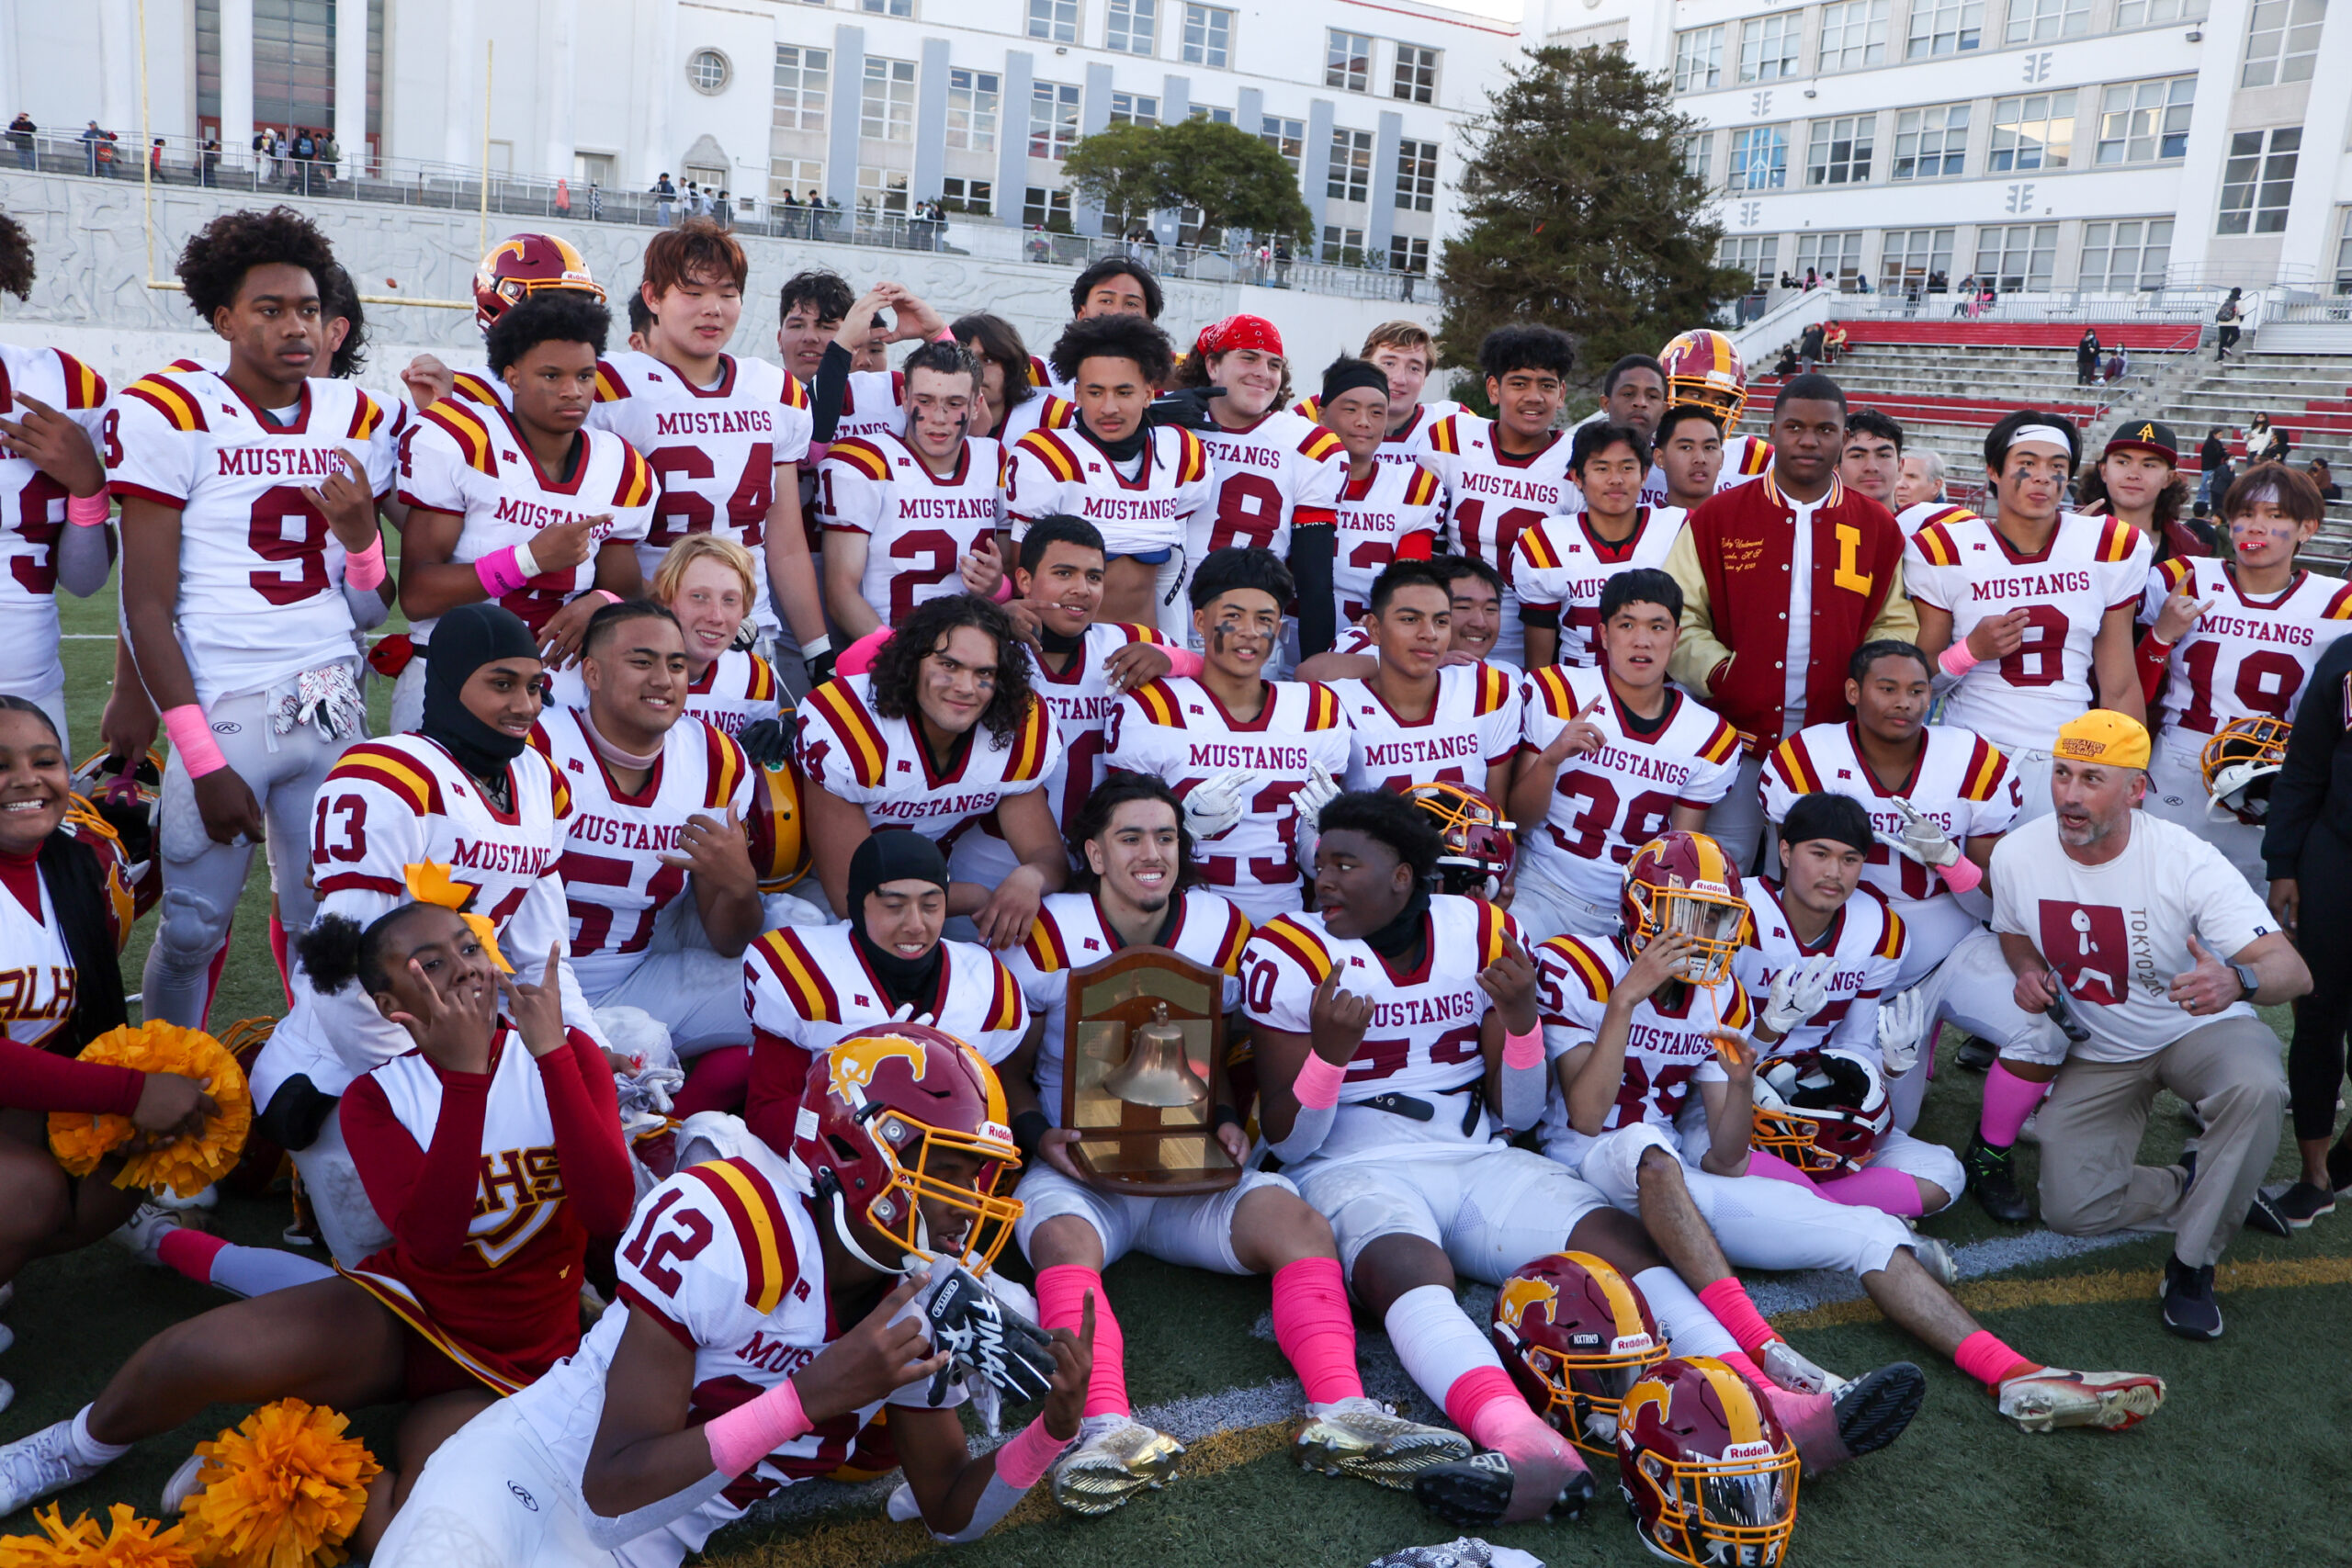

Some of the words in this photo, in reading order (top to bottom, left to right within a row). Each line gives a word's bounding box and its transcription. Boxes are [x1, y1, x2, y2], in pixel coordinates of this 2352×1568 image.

[656, 411, 773, 436] MUSTANGS
[218, 448, 346, 476] MUSTANGS
[1203, 439, 1282, 470] STANGS
[645, 443, 774, 547] 64
[1461, 471, 1559, 506] MUSTANGS
[899, 499, 997, 520] MUSTANGS
[1082, 497, 1179, 521] MUSTANGS
[1208, 472, 1283, 554] 8
[1334, 510, 1396, 532] STANGS
[248, 486, 331, 606] 9
[1834, 523, 1873, 598] L
[1971, 570, 2090, 602] MUSTANGS
[1999, 604, 2069, 687] 8
[2197, 613, 2314, 647] MUSTANGS
[2177, 640, 2305, 736] 19
[1189, 744, 1307, 770] MUSTANGS
[1365, 734, 1478, 767] MUSTANGS
[1580, 746, 1689, 786] MUSTANGS
[873, 792, 997, 820] MUSTANGS
[312, 794, 368, 864] 13
[1697, 883, 1728, 895] Riddell
[623, 1188, 713, 1299] 12
[1618, 1335, 1650, 1349] Riddell
[1730, 1444, 1770, 1460] Riddell
